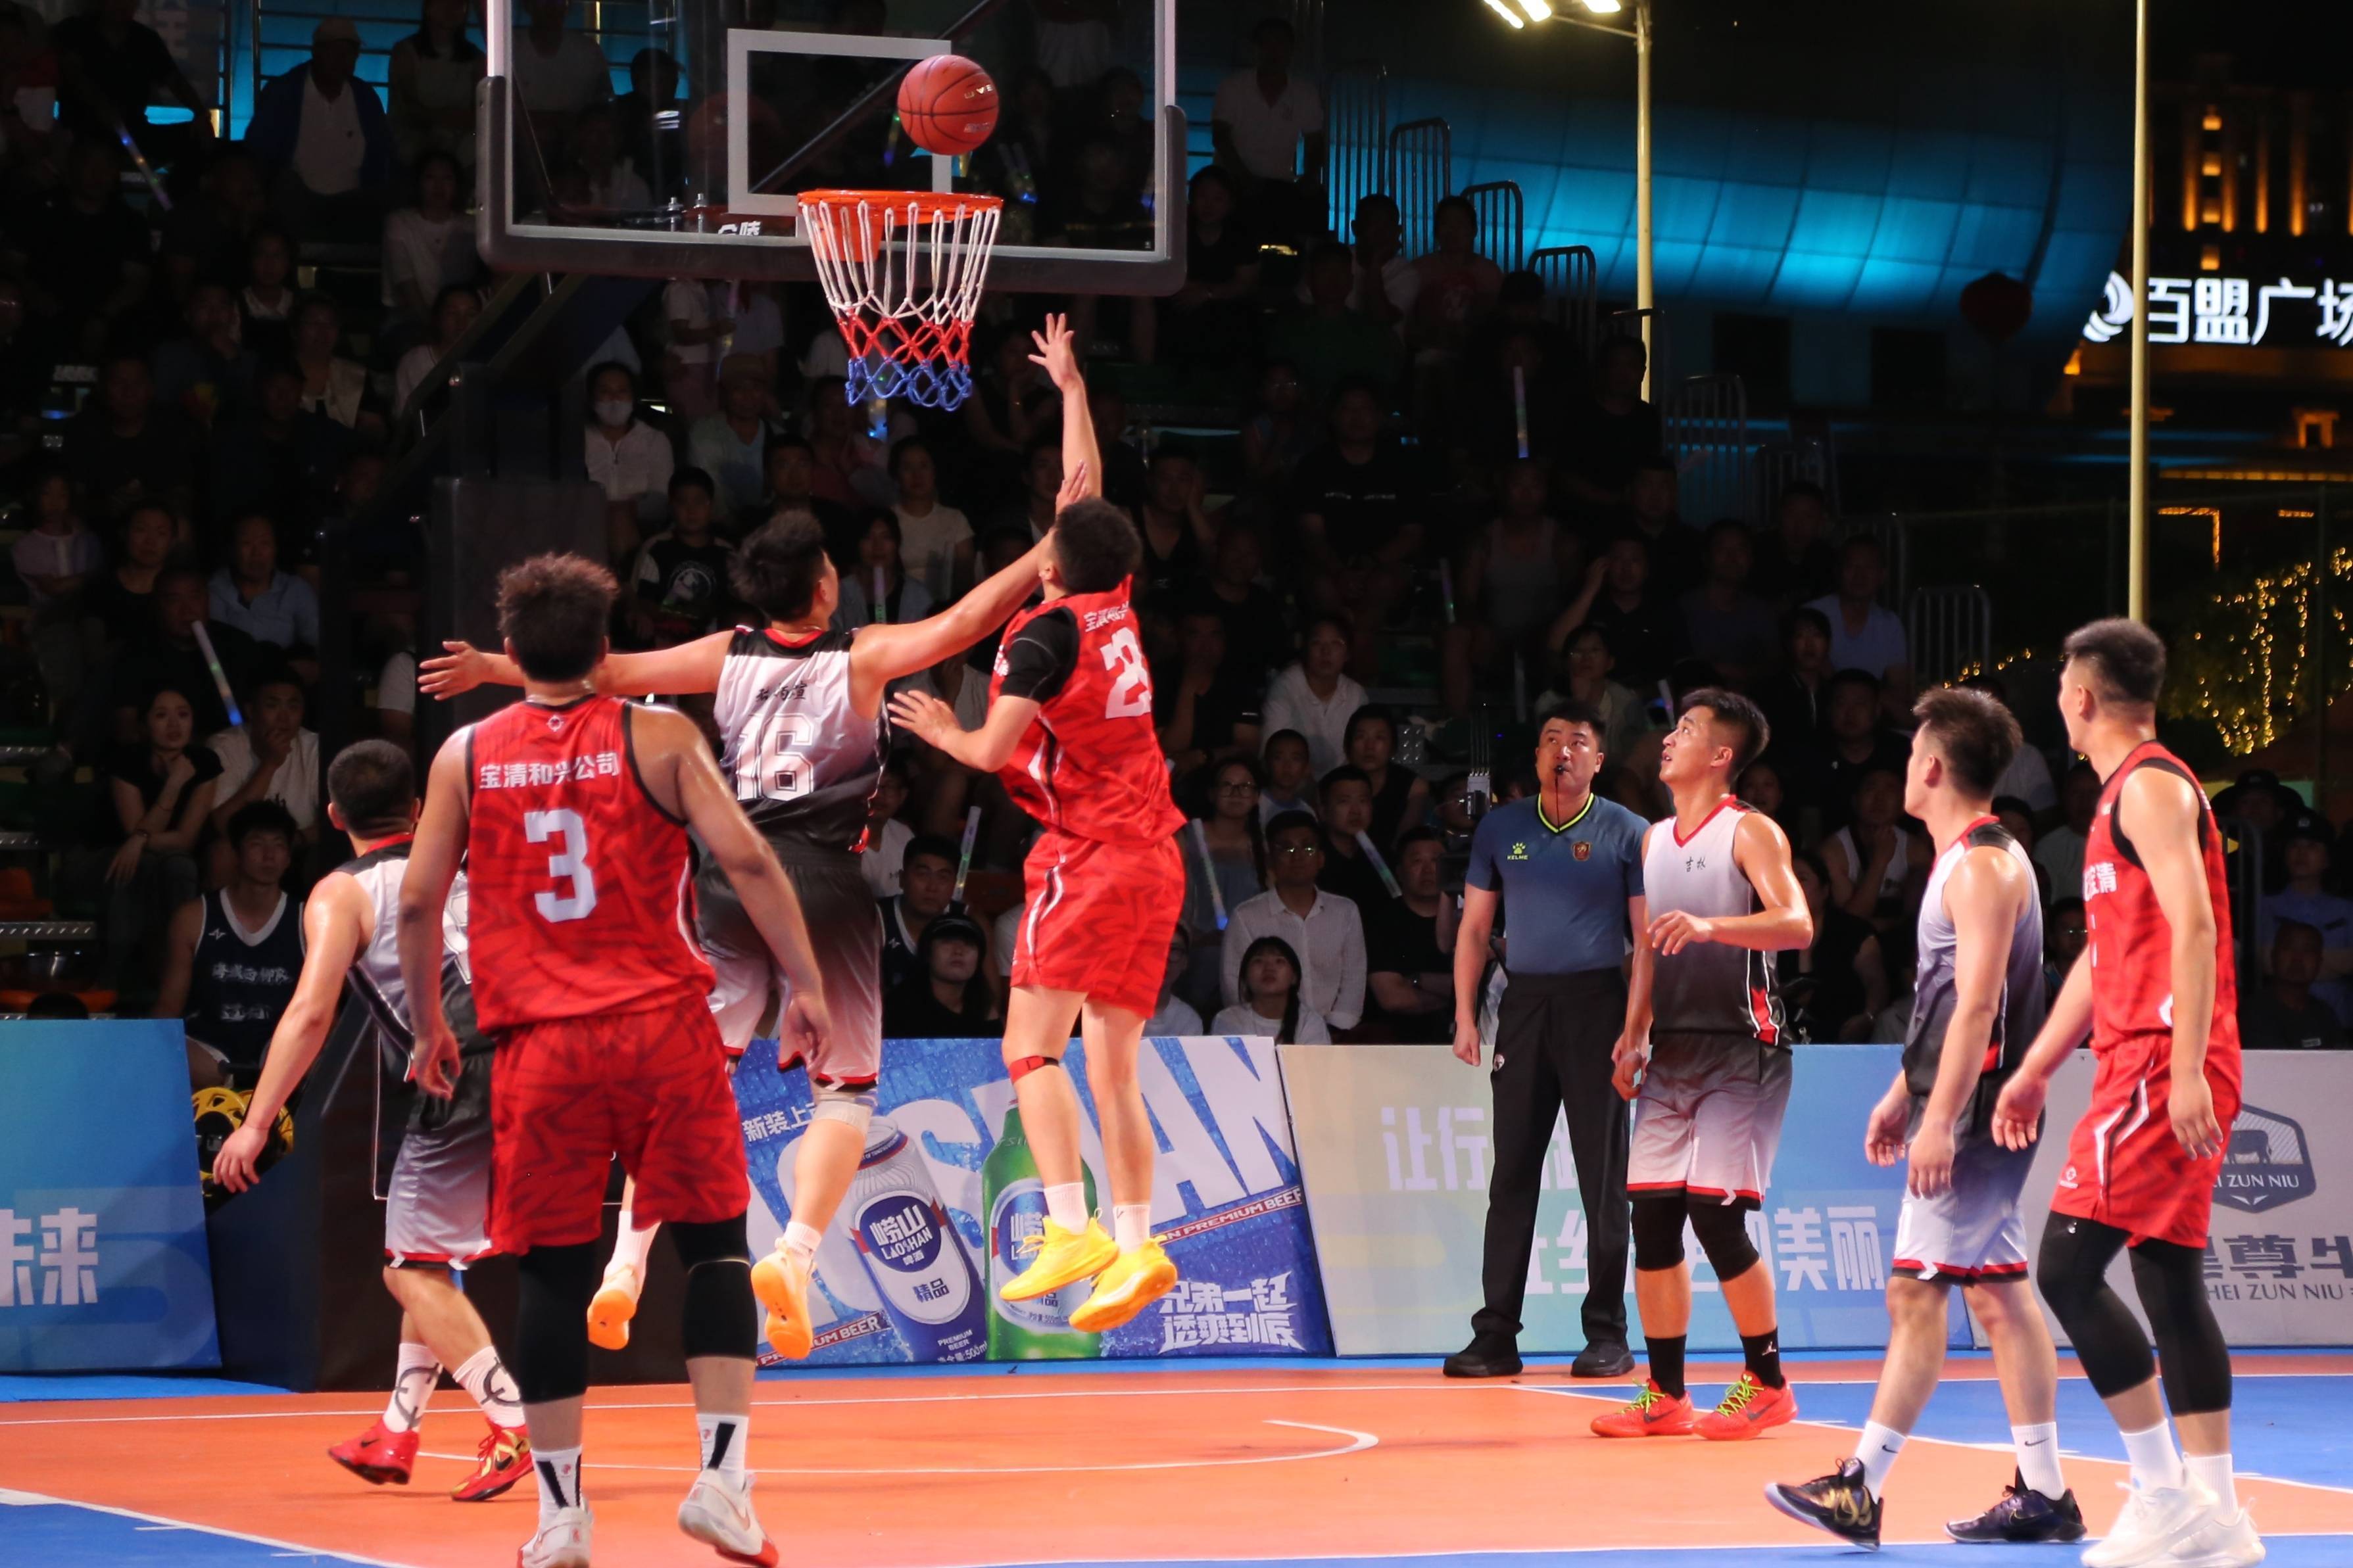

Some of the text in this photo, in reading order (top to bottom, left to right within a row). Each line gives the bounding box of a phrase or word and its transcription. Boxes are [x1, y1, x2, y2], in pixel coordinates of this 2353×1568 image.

[736, 712, 814, 801] 16
[523, 808, 597, 923] 3
[2226, 1174, 2265, 1187] ZUN
[2268, 1174, 2300, 1188] NIU
[869, 1204, 927, 1246] 崂山
[1184, 1203, 1264, 1236] PREMIUM
[881, 1227, 933, 1260] LAOSHAN
[913, 1277, 950, 1303] 精品
[1159, 1271, 1298, 1314] 兄弟一起
[2246, 1284, 2296, 1300] ZUN
[2303, 1285, 2344, 1300] NIU
[839, 1316, 881, 1340] BEER
[937, 1329, 973, 1346] PREMIUM
[948, 1339, 970, 1351] BEER
